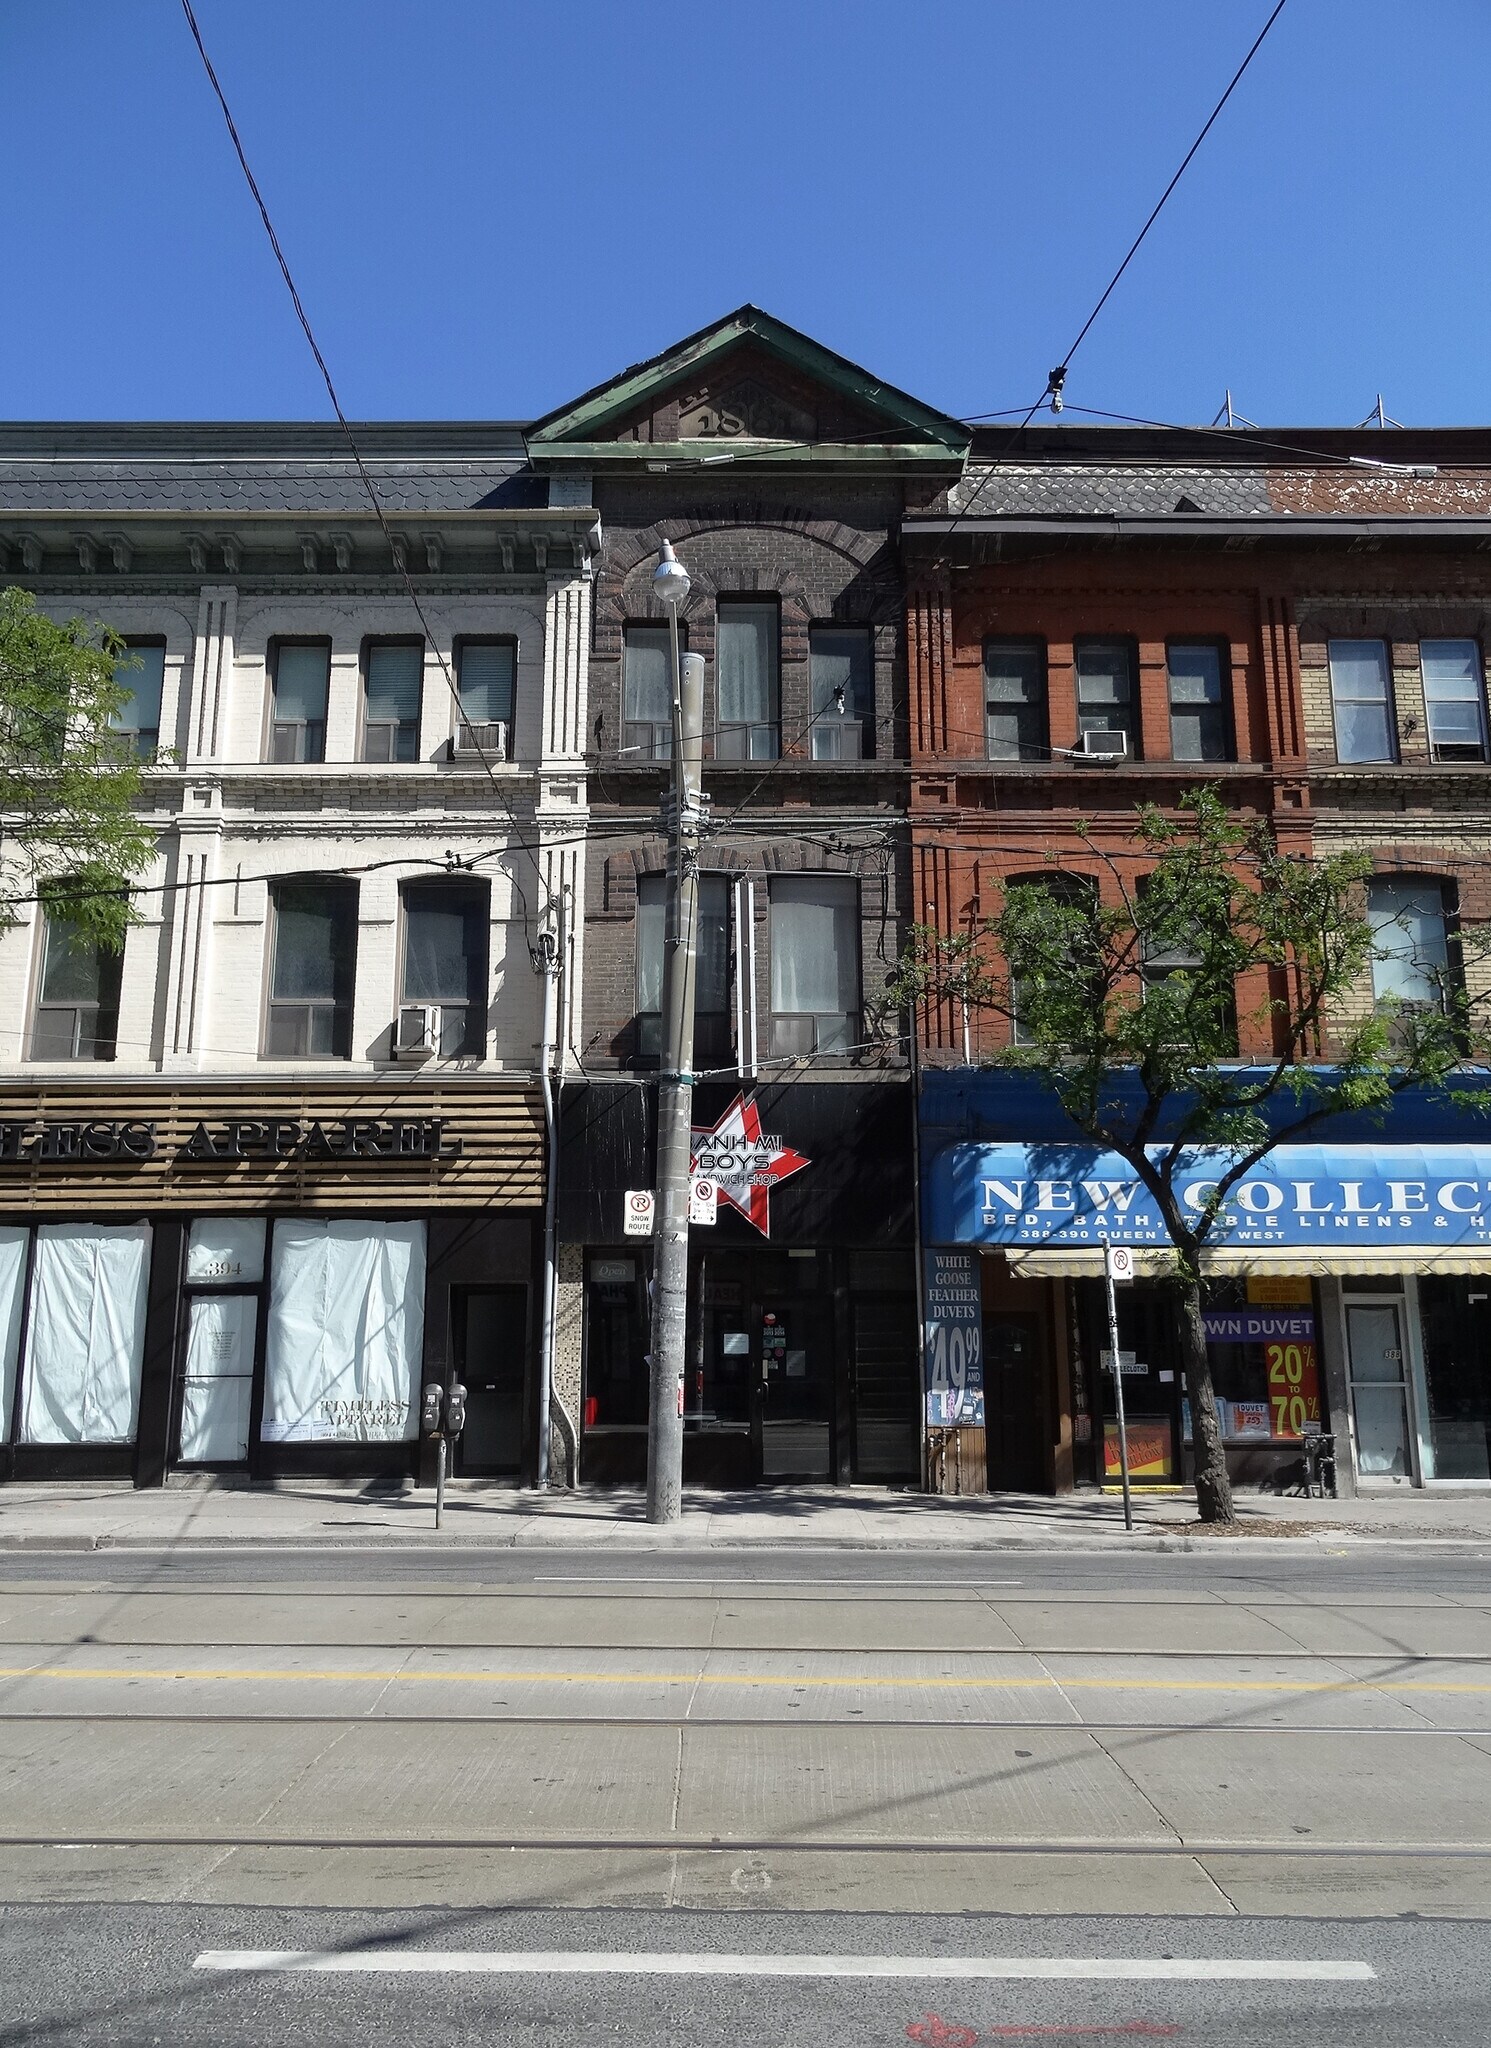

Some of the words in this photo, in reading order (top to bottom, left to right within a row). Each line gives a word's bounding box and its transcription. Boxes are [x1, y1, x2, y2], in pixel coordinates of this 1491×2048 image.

[184, 1121, 463, 1156] APPAREL
[690, 1135, 747, 1150] ANH
[755, 1135, 782, 1150] MI
[700, 1154, 770, 1169] BOYS
[747, 1174, 778, 1185] SHOP
[980, 1180, 1142, 1211] NEW
[1184, 1180, 1491, 1213] COLLEC
[983, 1214, 1052, 1227] BED,
[1074, 1215, 1162, 1228] BATH,
[1300, 1216, 1412, 1227] LINENS
[1434, 1216, 1448, 1227] &
[1021, 1230, 1089, 1238] 388-390
[1097, 1230, 1156, 1239] QUEEN
[1238, 1231, 1285, 1239] WEST
[209, 1262, 242, 1275] 394
[935, 1256, 971, 1268] WHITE
[935, 1272, 971, 1285] GOOSE
[929, 1289, 979, 1301] FEATHER
[933, 1305, 975, 1318] DUVETS
[1247, 1320, 1313, 1334] DUVET
[1385, 1350, 1400, 1358] 388
[967, 1372, 980, 1382] AND
[1288, 1385, 1300, 1393] TO
[320, 1400, 411, 1412] TIMELESS
[325, 1413, 407, 1427] APPAREL
